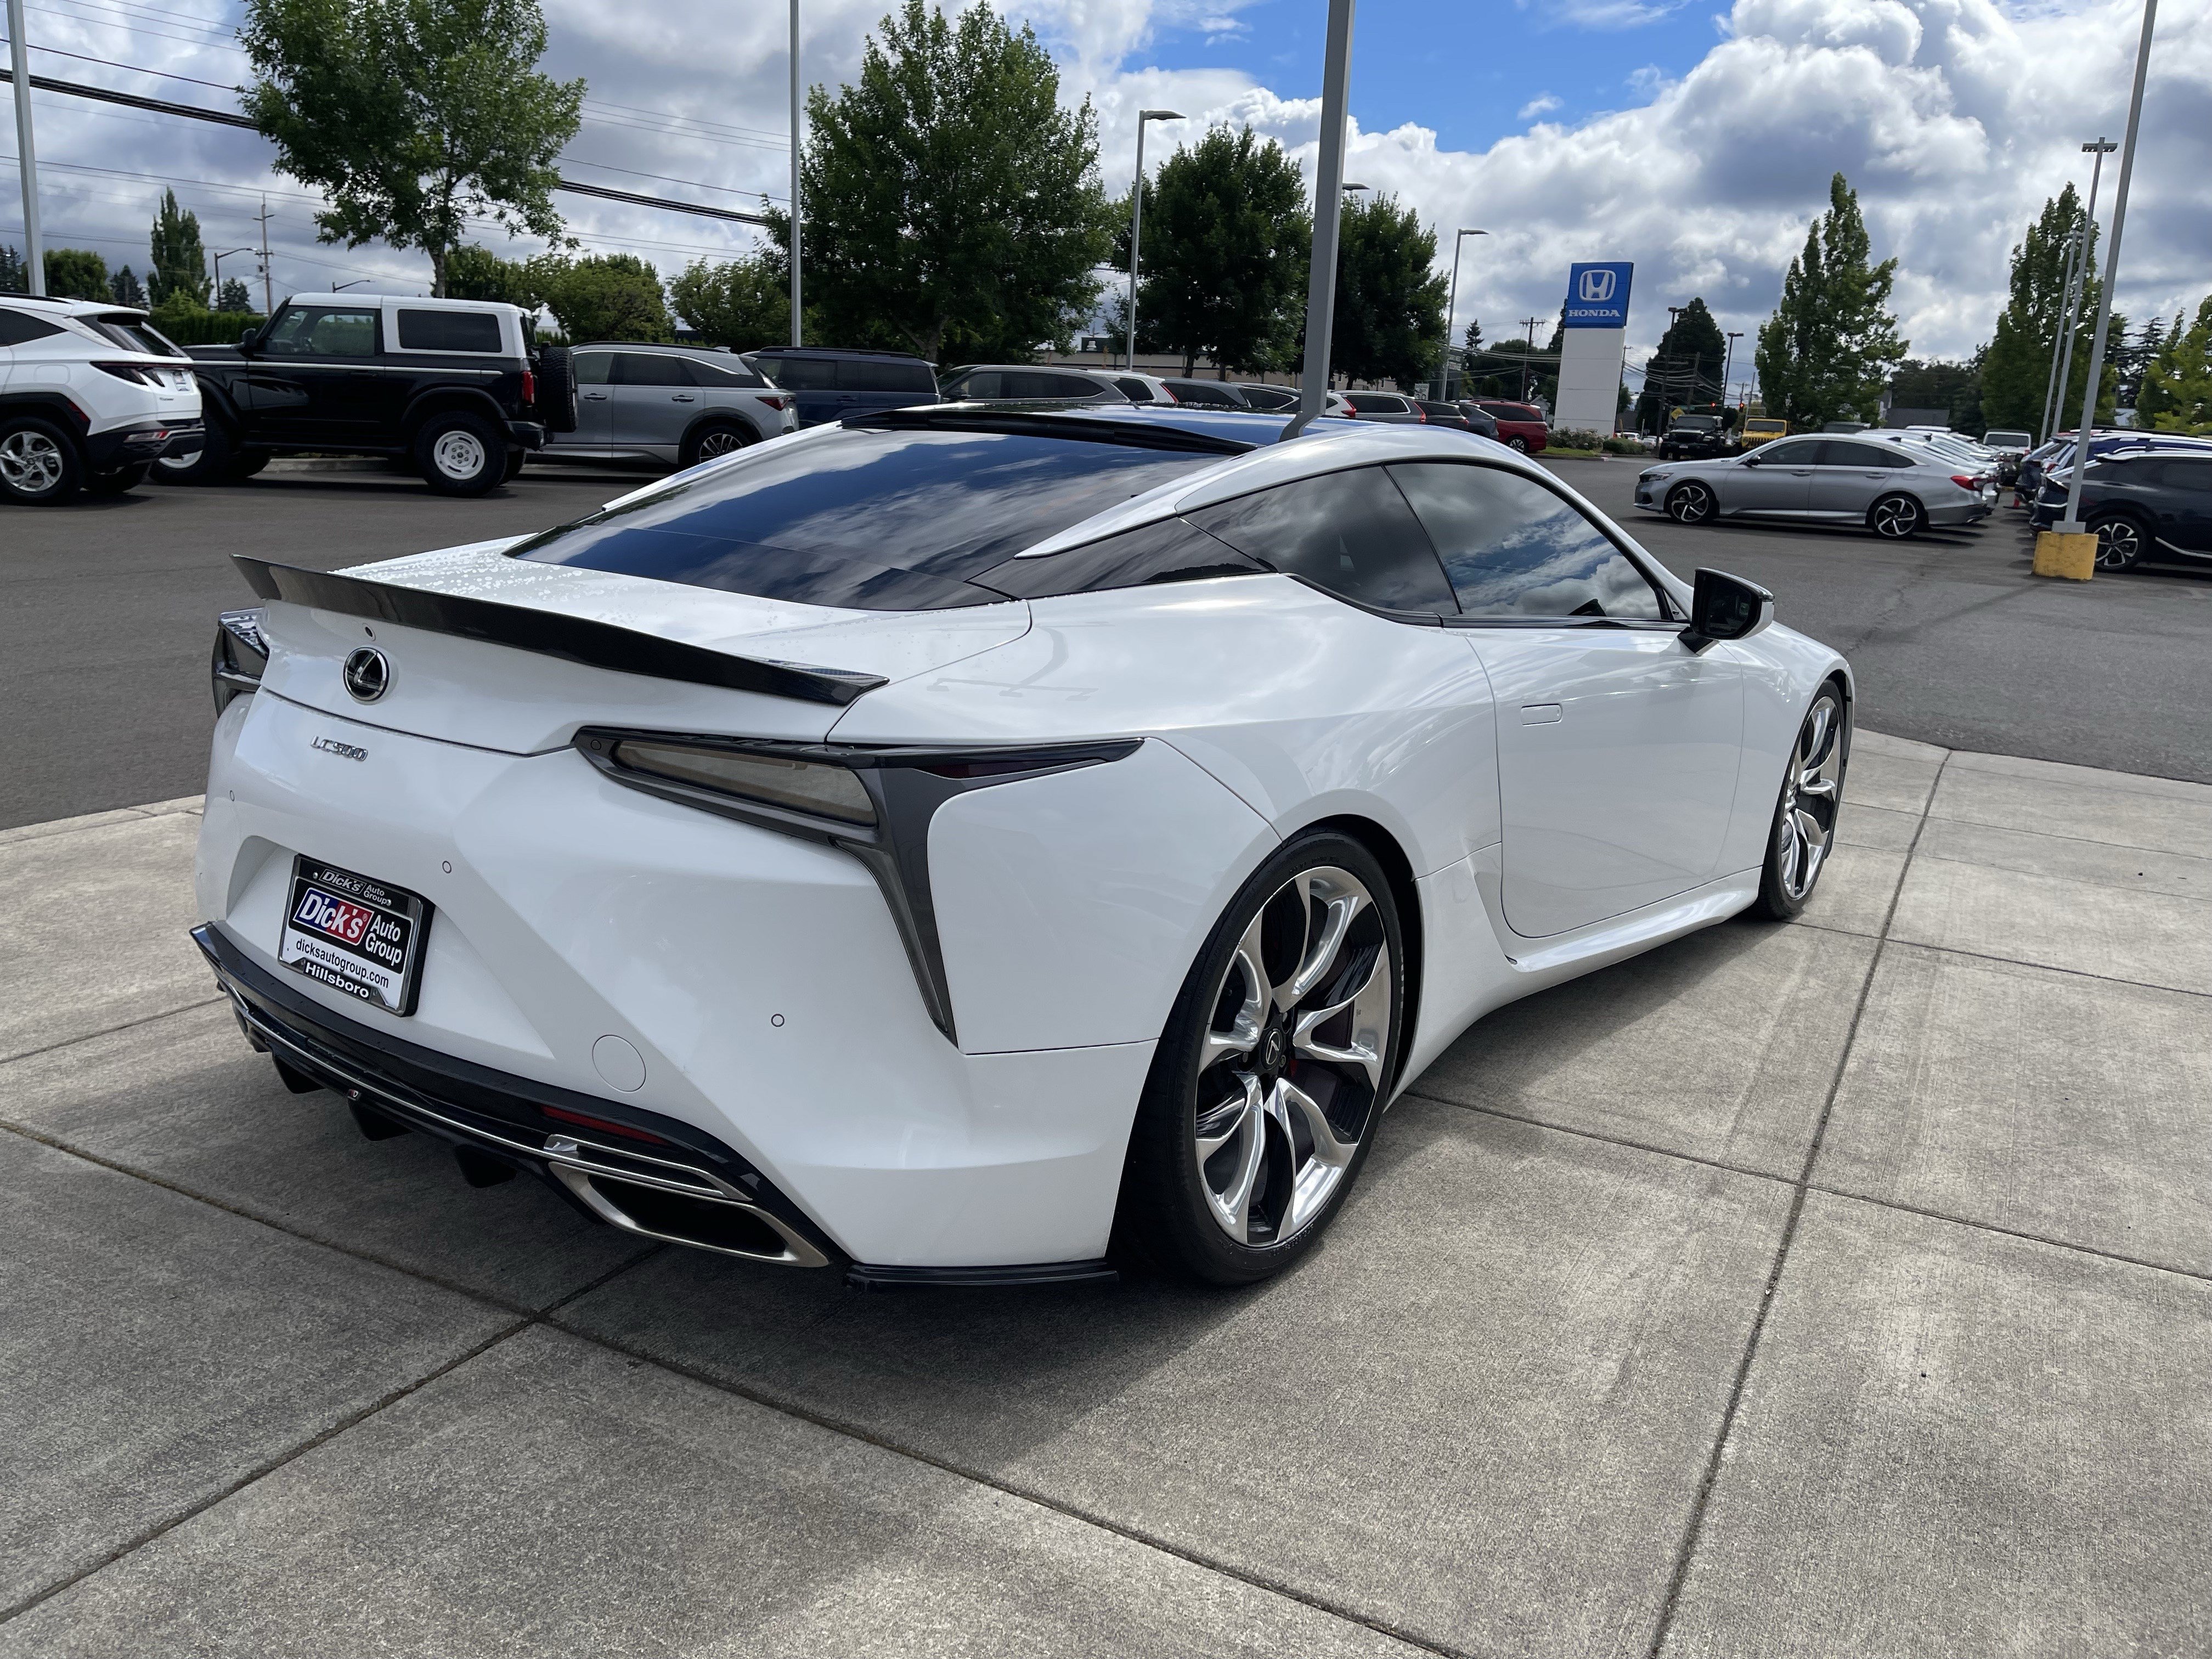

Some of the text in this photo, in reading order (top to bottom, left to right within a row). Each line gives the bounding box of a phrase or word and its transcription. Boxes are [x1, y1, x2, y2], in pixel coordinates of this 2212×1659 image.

[310, 735, 369, 761] LC500
[322, 871, 362, 892] Dick's
[366, 884, 385, 896] Auto
[363, 891, 387, 905] Group
[370, 915, 401, 942] Auto
[365, 932, 403, 966] Group
[296, 938, 390, 989] dicksautogroup.com
[305, 962, 370, 998] Hillsboro
